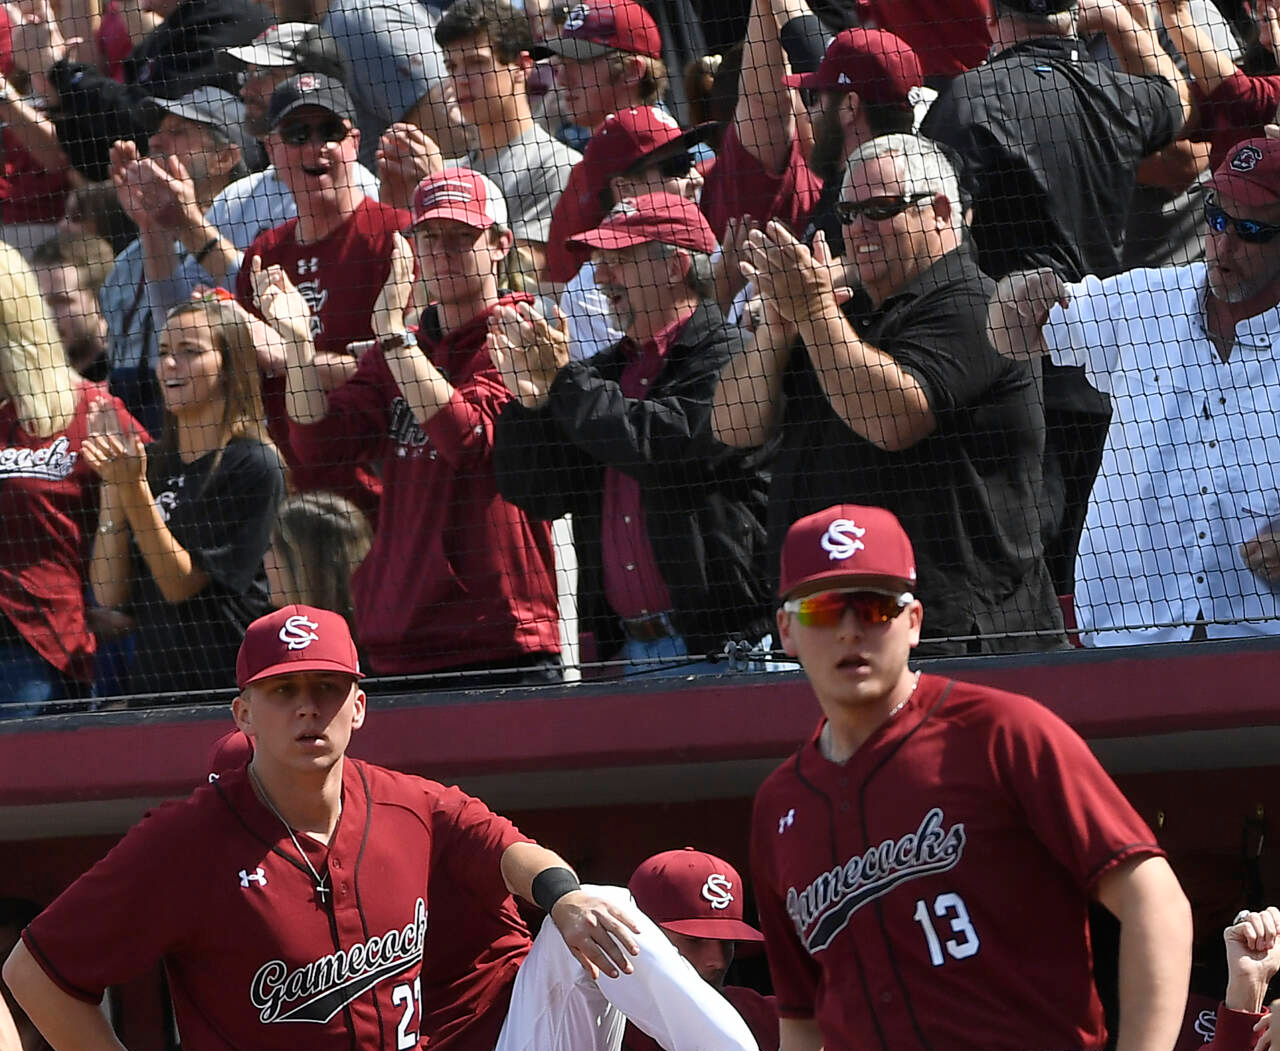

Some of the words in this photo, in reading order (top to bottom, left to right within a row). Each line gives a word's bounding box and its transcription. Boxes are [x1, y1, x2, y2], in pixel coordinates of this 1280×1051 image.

[821, 519, 866, 561] SC
[279, 615, 319, 650] SC
[701, 873, 734, 910] SC
[786, 807, 966, 950] Gamecocks
[914, 892, 980, 967] 13
